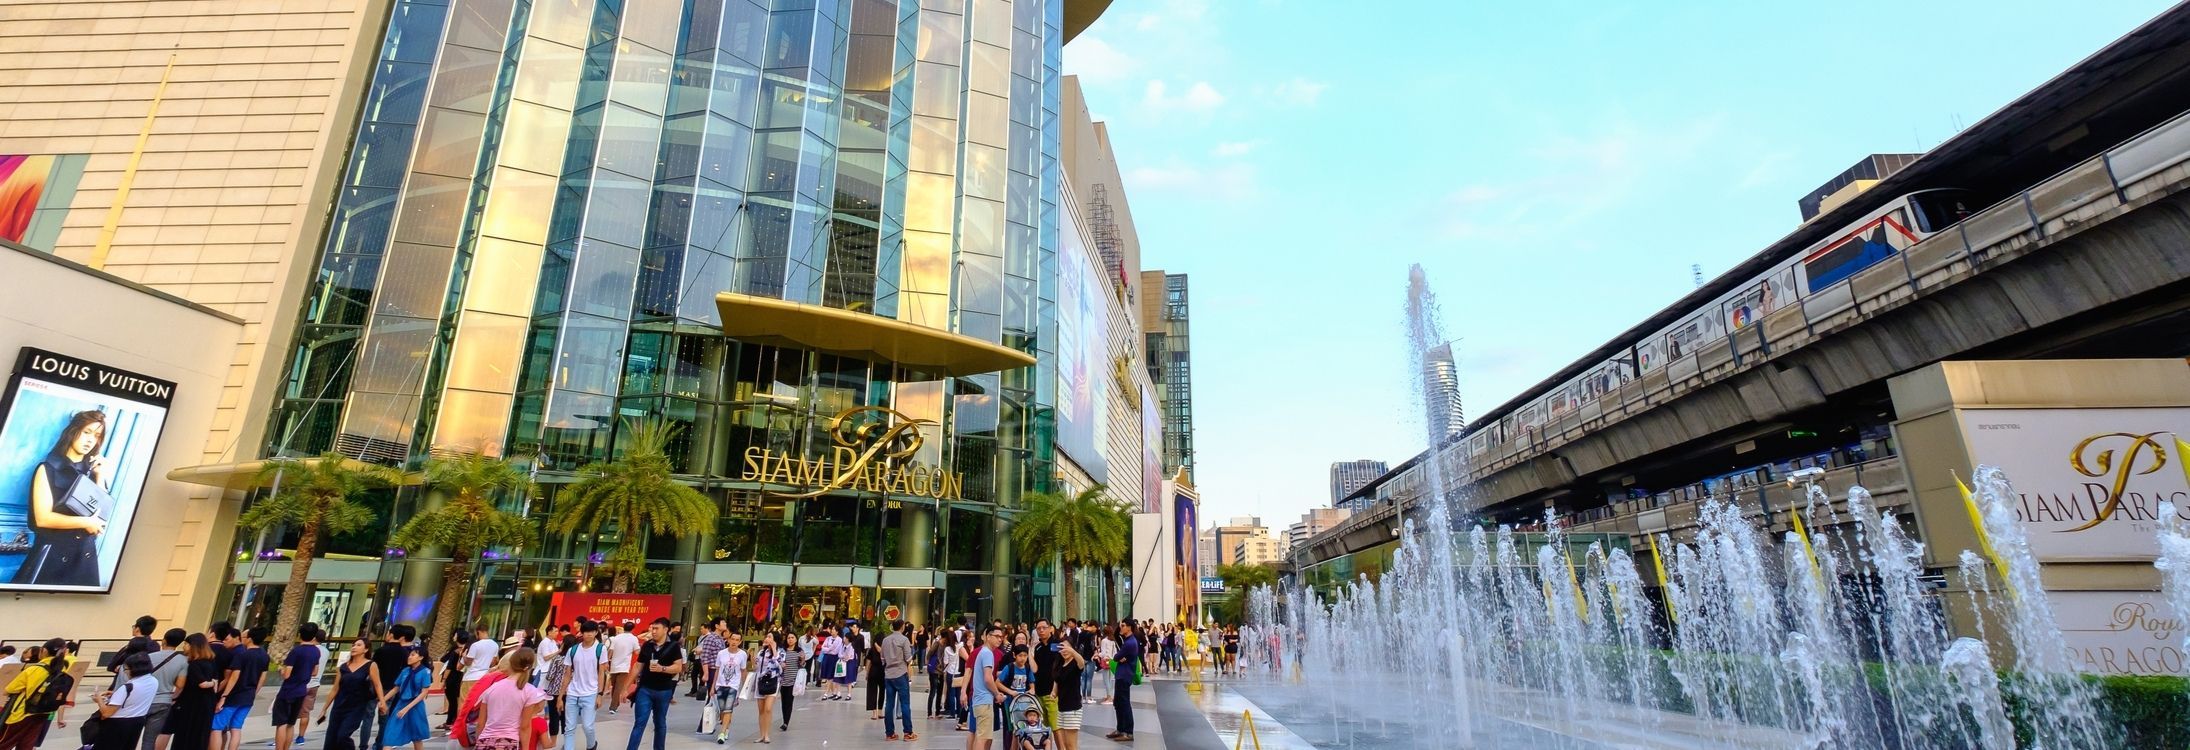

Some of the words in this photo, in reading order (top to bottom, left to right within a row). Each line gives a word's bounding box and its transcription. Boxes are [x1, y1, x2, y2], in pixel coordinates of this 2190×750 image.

[31, 354, 92, 381] LOUIS
[98, 369, 171, 400] VUITTON
[741, 446, 824, 487] SIAM
[831, 445, 963, 501] PARAGON
[597, 598, 610, 606] SIAM
[2064, 646, 2188, 674] PARAGO
